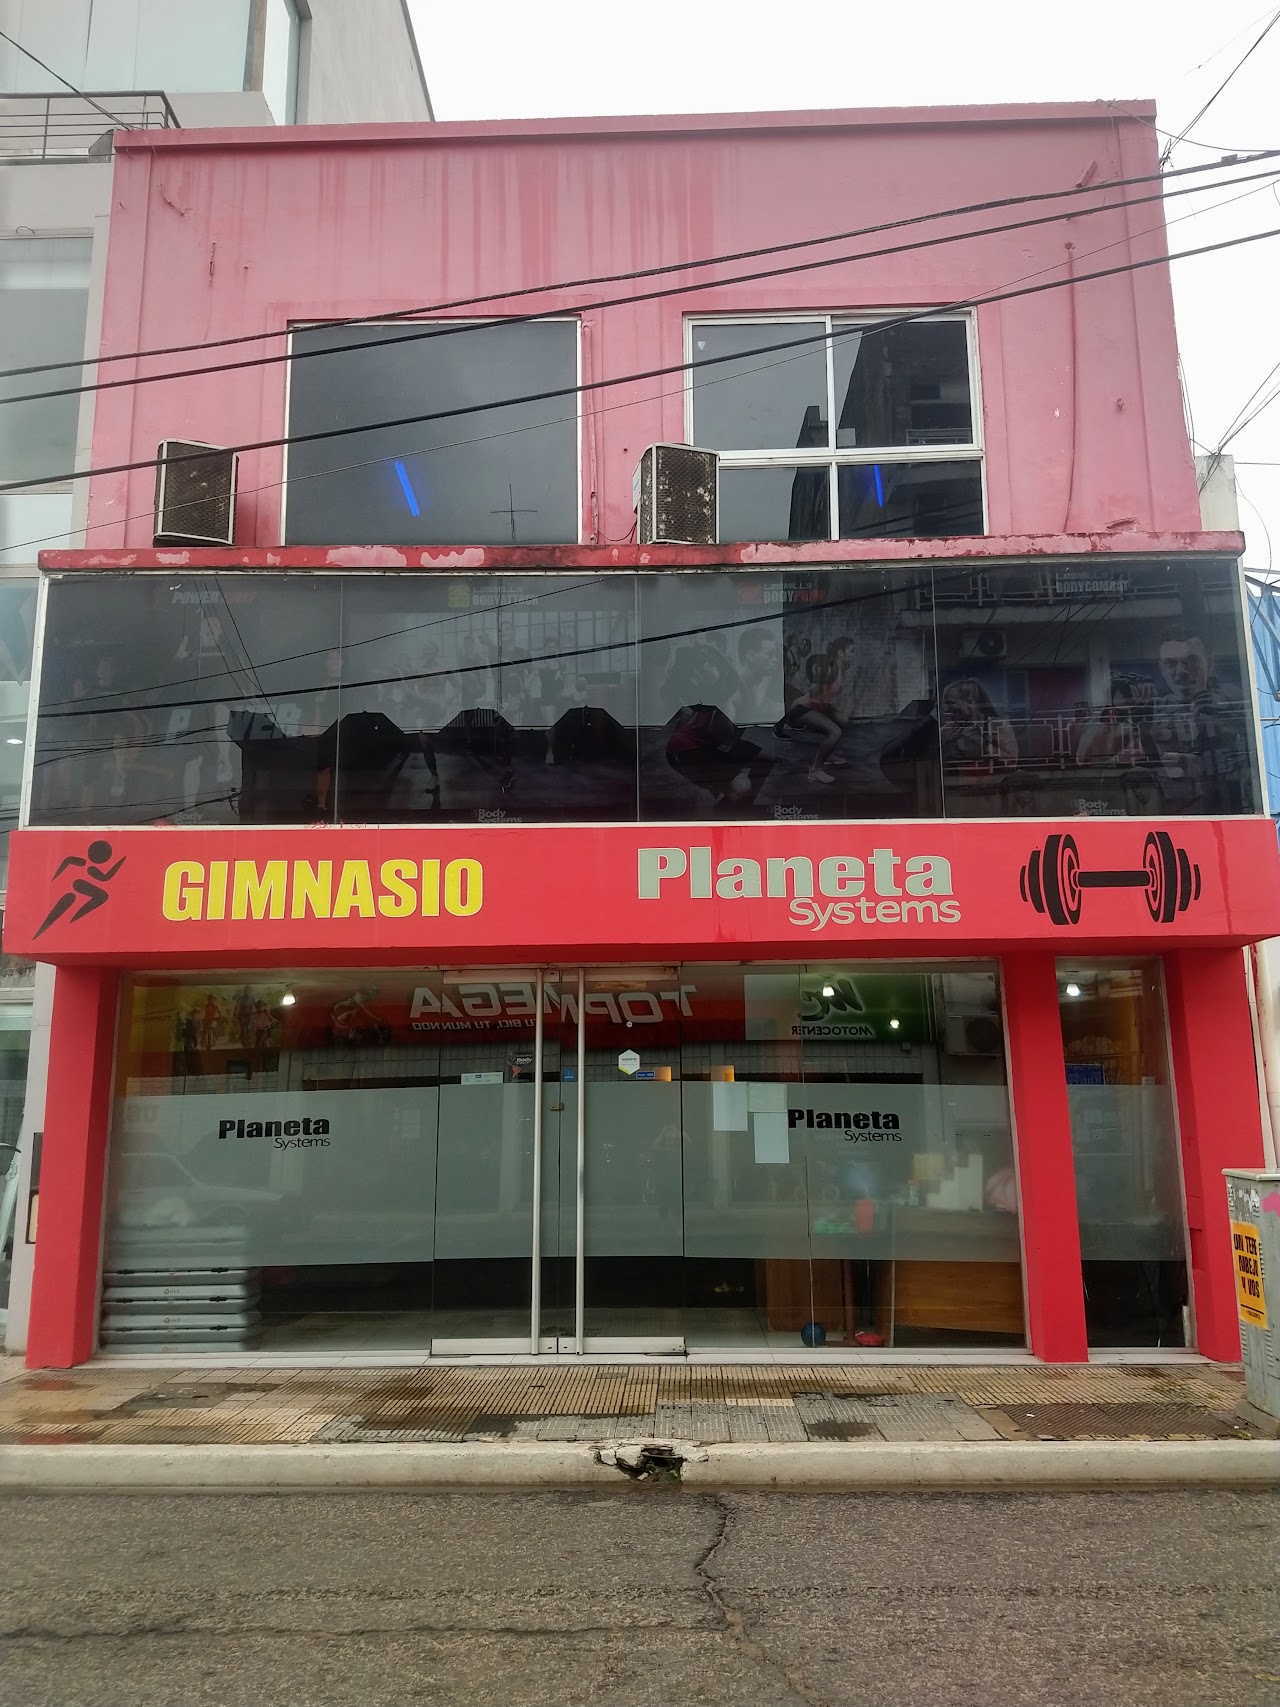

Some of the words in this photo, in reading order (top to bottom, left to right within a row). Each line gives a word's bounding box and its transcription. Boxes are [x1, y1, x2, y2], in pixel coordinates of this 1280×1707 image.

[774, 804, 803, 816] Body
[1079, 798, 1109, 810] Body
[478, 808, 507, 819] Body
[637, 846, 955, 899] Planeta
[162, 858, 484, 921] GIMNASIO
[788, 897, 962, 932] Systems
[786, 1108, 900, 1130] Planeta
[218, 1117, 330, 1140] Planeta
[844, 1130, 903, 1144] Systems
[273, 1137, 331, 1152] Systems
